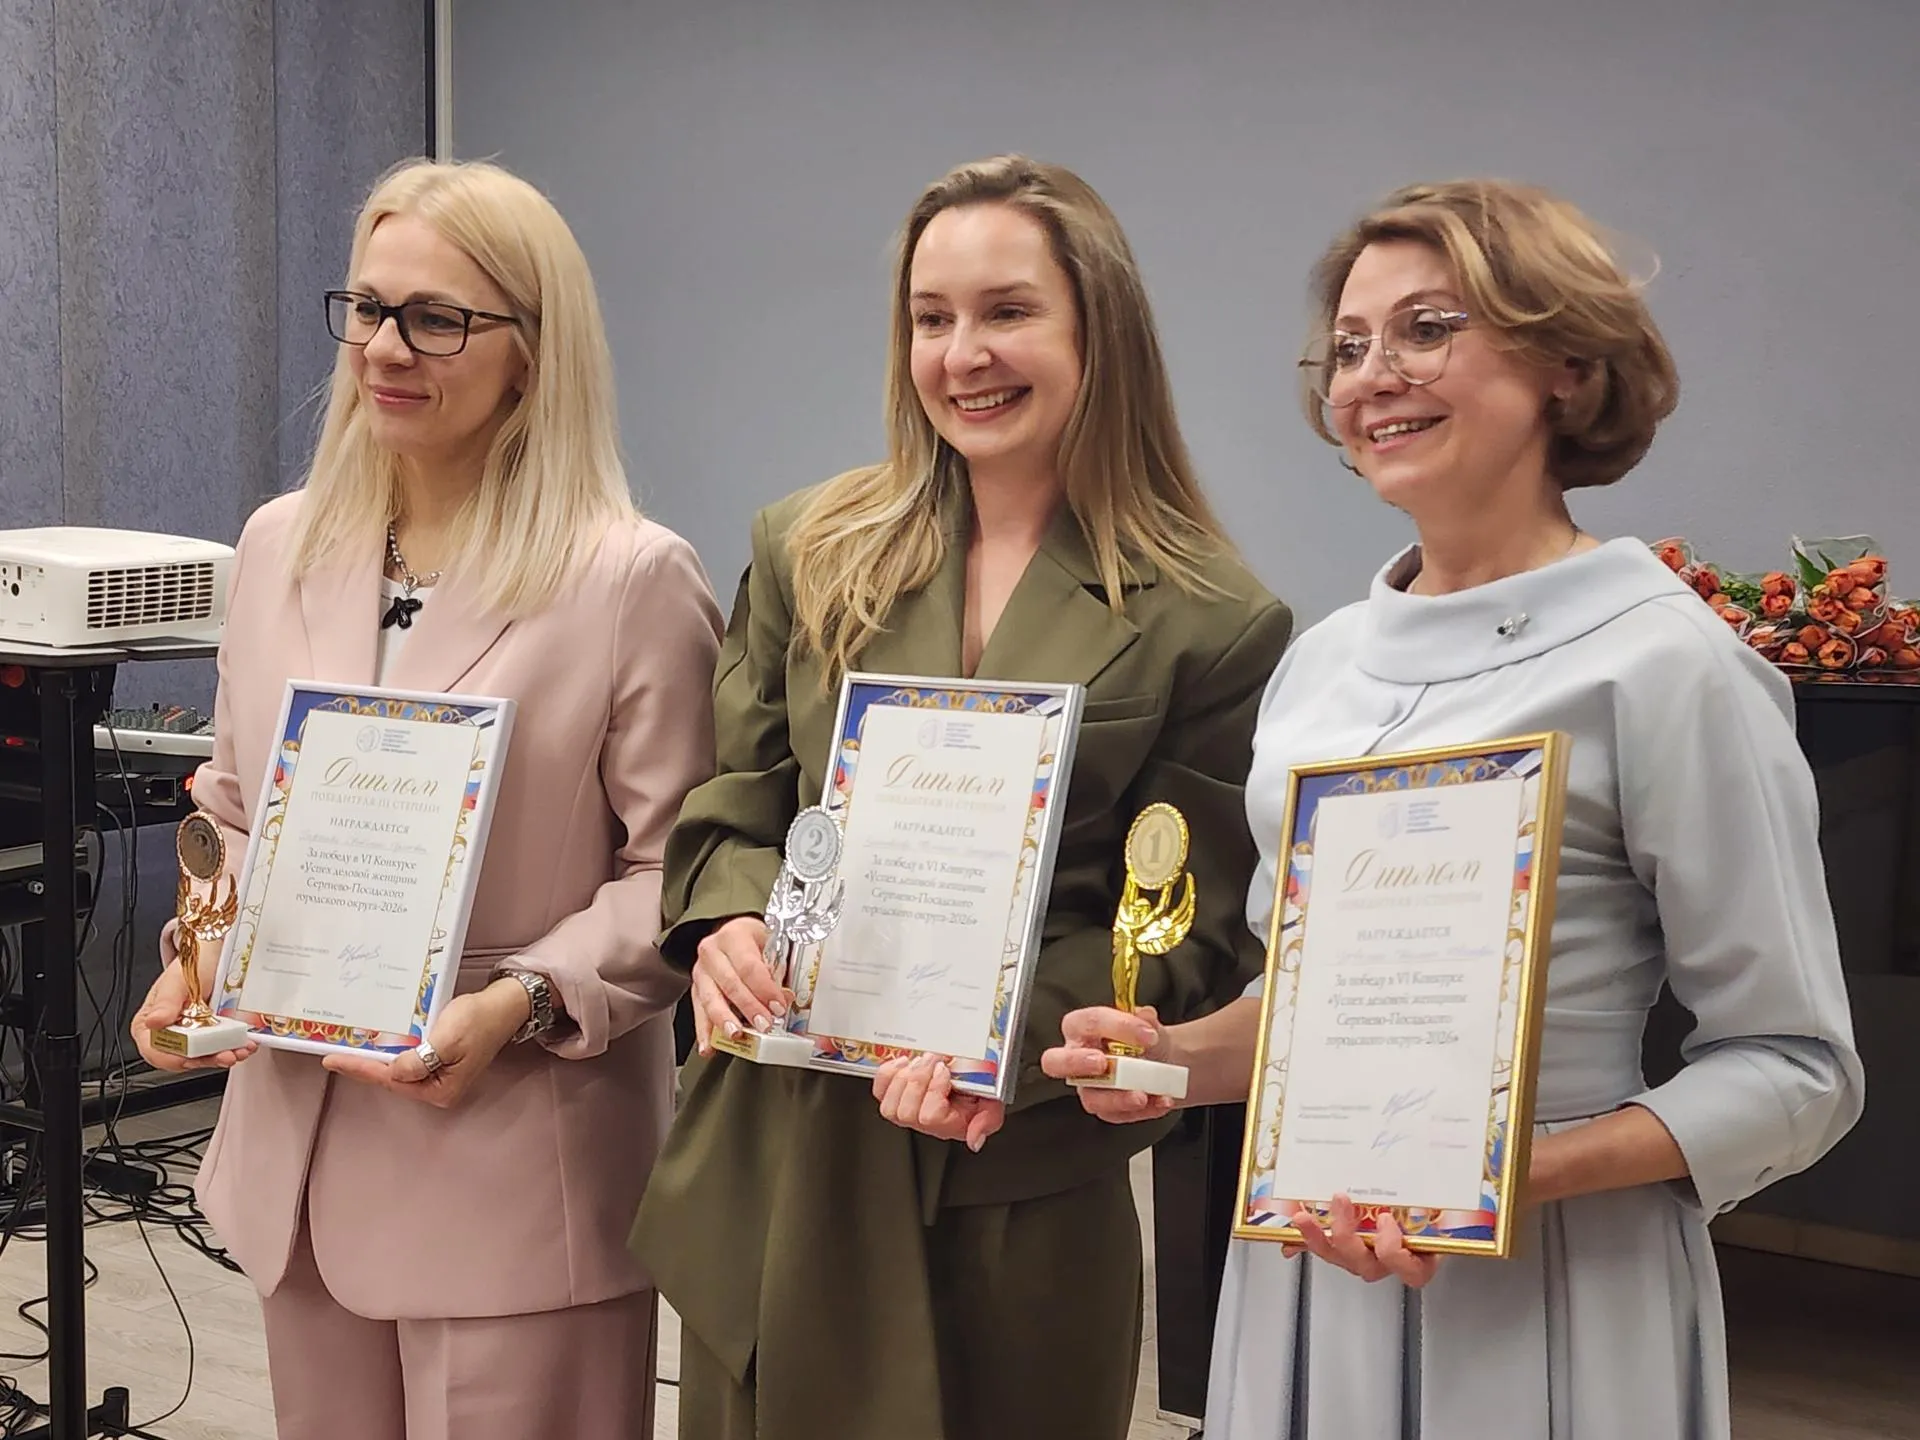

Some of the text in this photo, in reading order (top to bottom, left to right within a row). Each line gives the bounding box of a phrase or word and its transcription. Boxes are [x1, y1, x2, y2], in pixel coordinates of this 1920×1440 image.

[319, 757, 439, 797] Диплом
[883, 754, 1005, 797] Диплом
[329, 817, 410, 834] НАГРАЖДАЕТСЯ
[893, 820, 975, 837] НАГРАЖДАЕТСЯ
[805, 827, 823, 859] 2
[1148, 828, 1163, 864] 1
[307, 847, 319, 858] За
[320, 850, 352, 865] победу
[361, 853, 372, 865] VI
[373, 855, 417, 871] Конкурсе
[1341, 848, 1481, 893] Диплом
[333, 868, 370, 881] деловой
[371, 873, 418, 886] женщины
[296, 893, 346, 908] городского
[1356, 926, 1451, 942] НАГРАЖДАЕТСЯ
